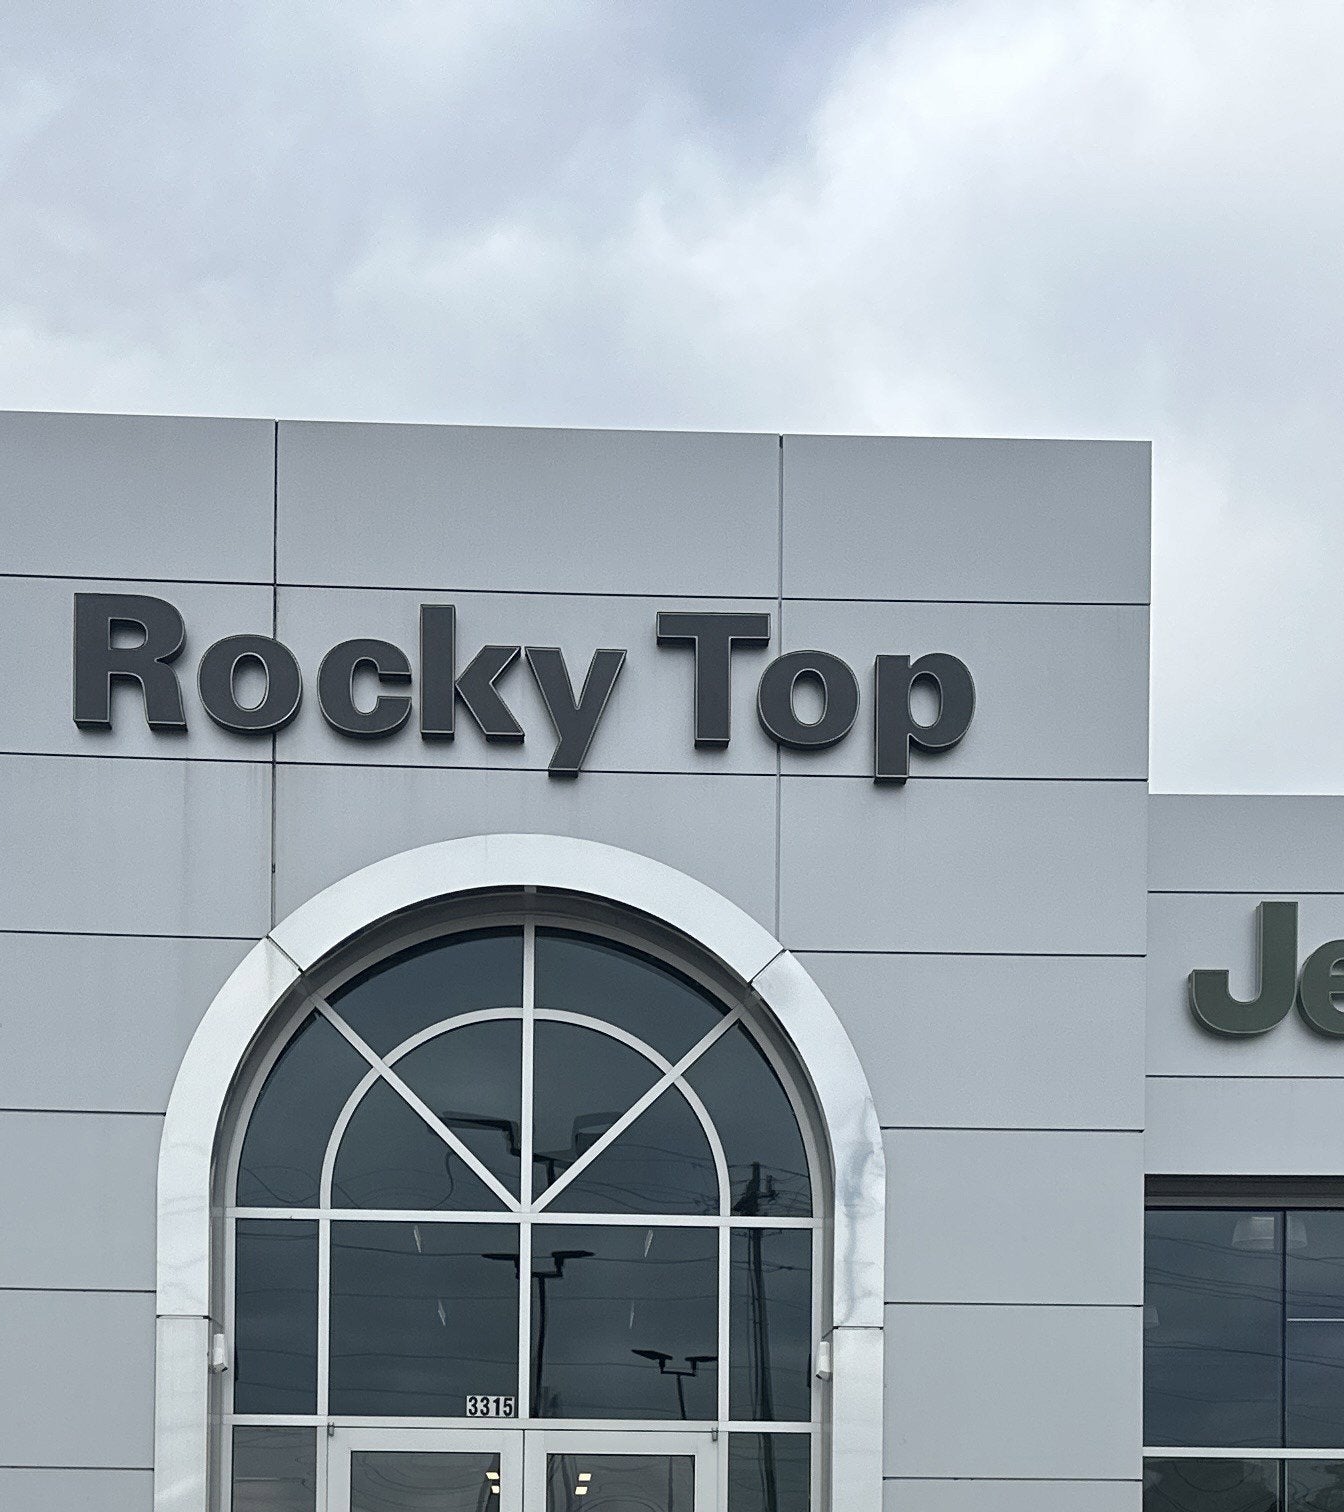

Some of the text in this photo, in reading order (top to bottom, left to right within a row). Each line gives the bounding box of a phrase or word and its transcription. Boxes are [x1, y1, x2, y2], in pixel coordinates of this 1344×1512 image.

[72, 592, 977, 784] Rocky Top
[468, 1396, 514, 1417] 3315
